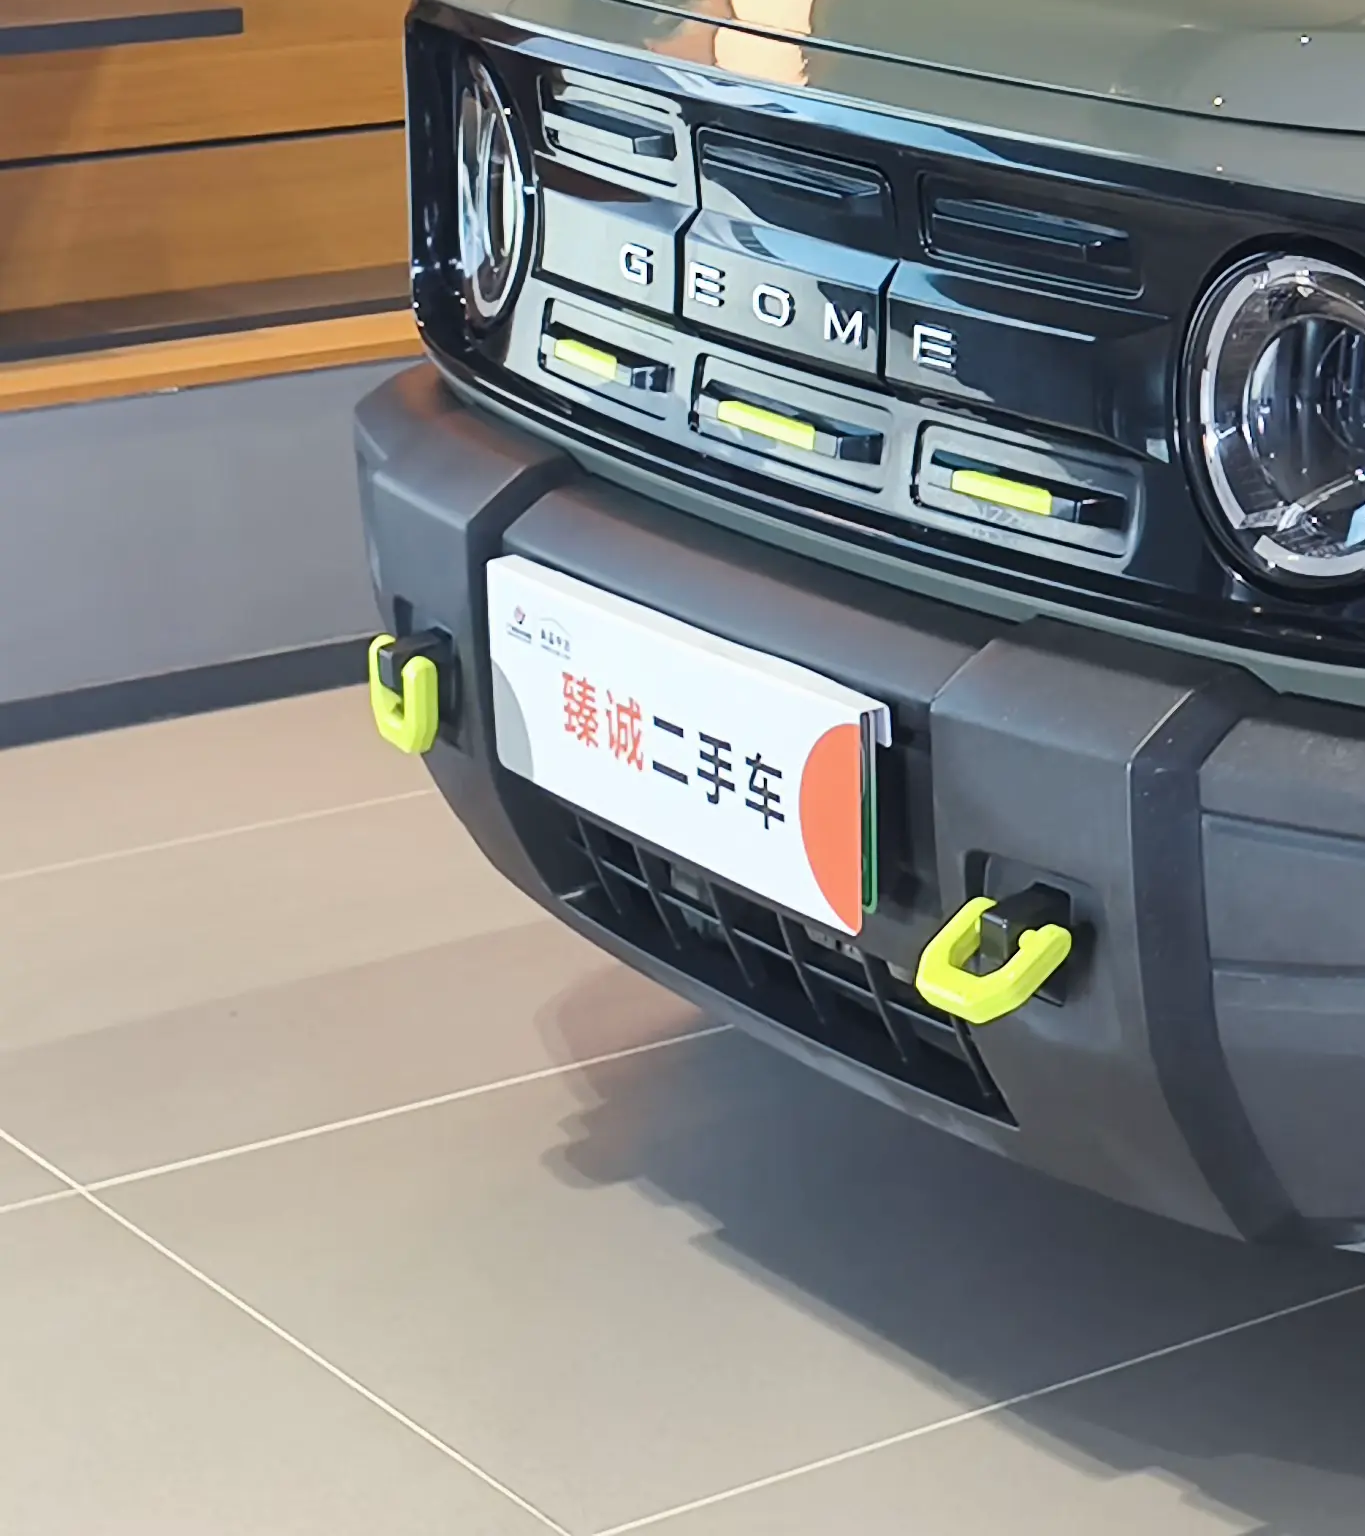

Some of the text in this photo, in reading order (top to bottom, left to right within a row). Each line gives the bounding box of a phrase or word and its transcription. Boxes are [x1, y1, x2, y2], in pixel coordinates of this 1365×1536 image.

[618, 242, 958, 374] GEOME
[561, 671, 785, 830] 臻诚二手车
